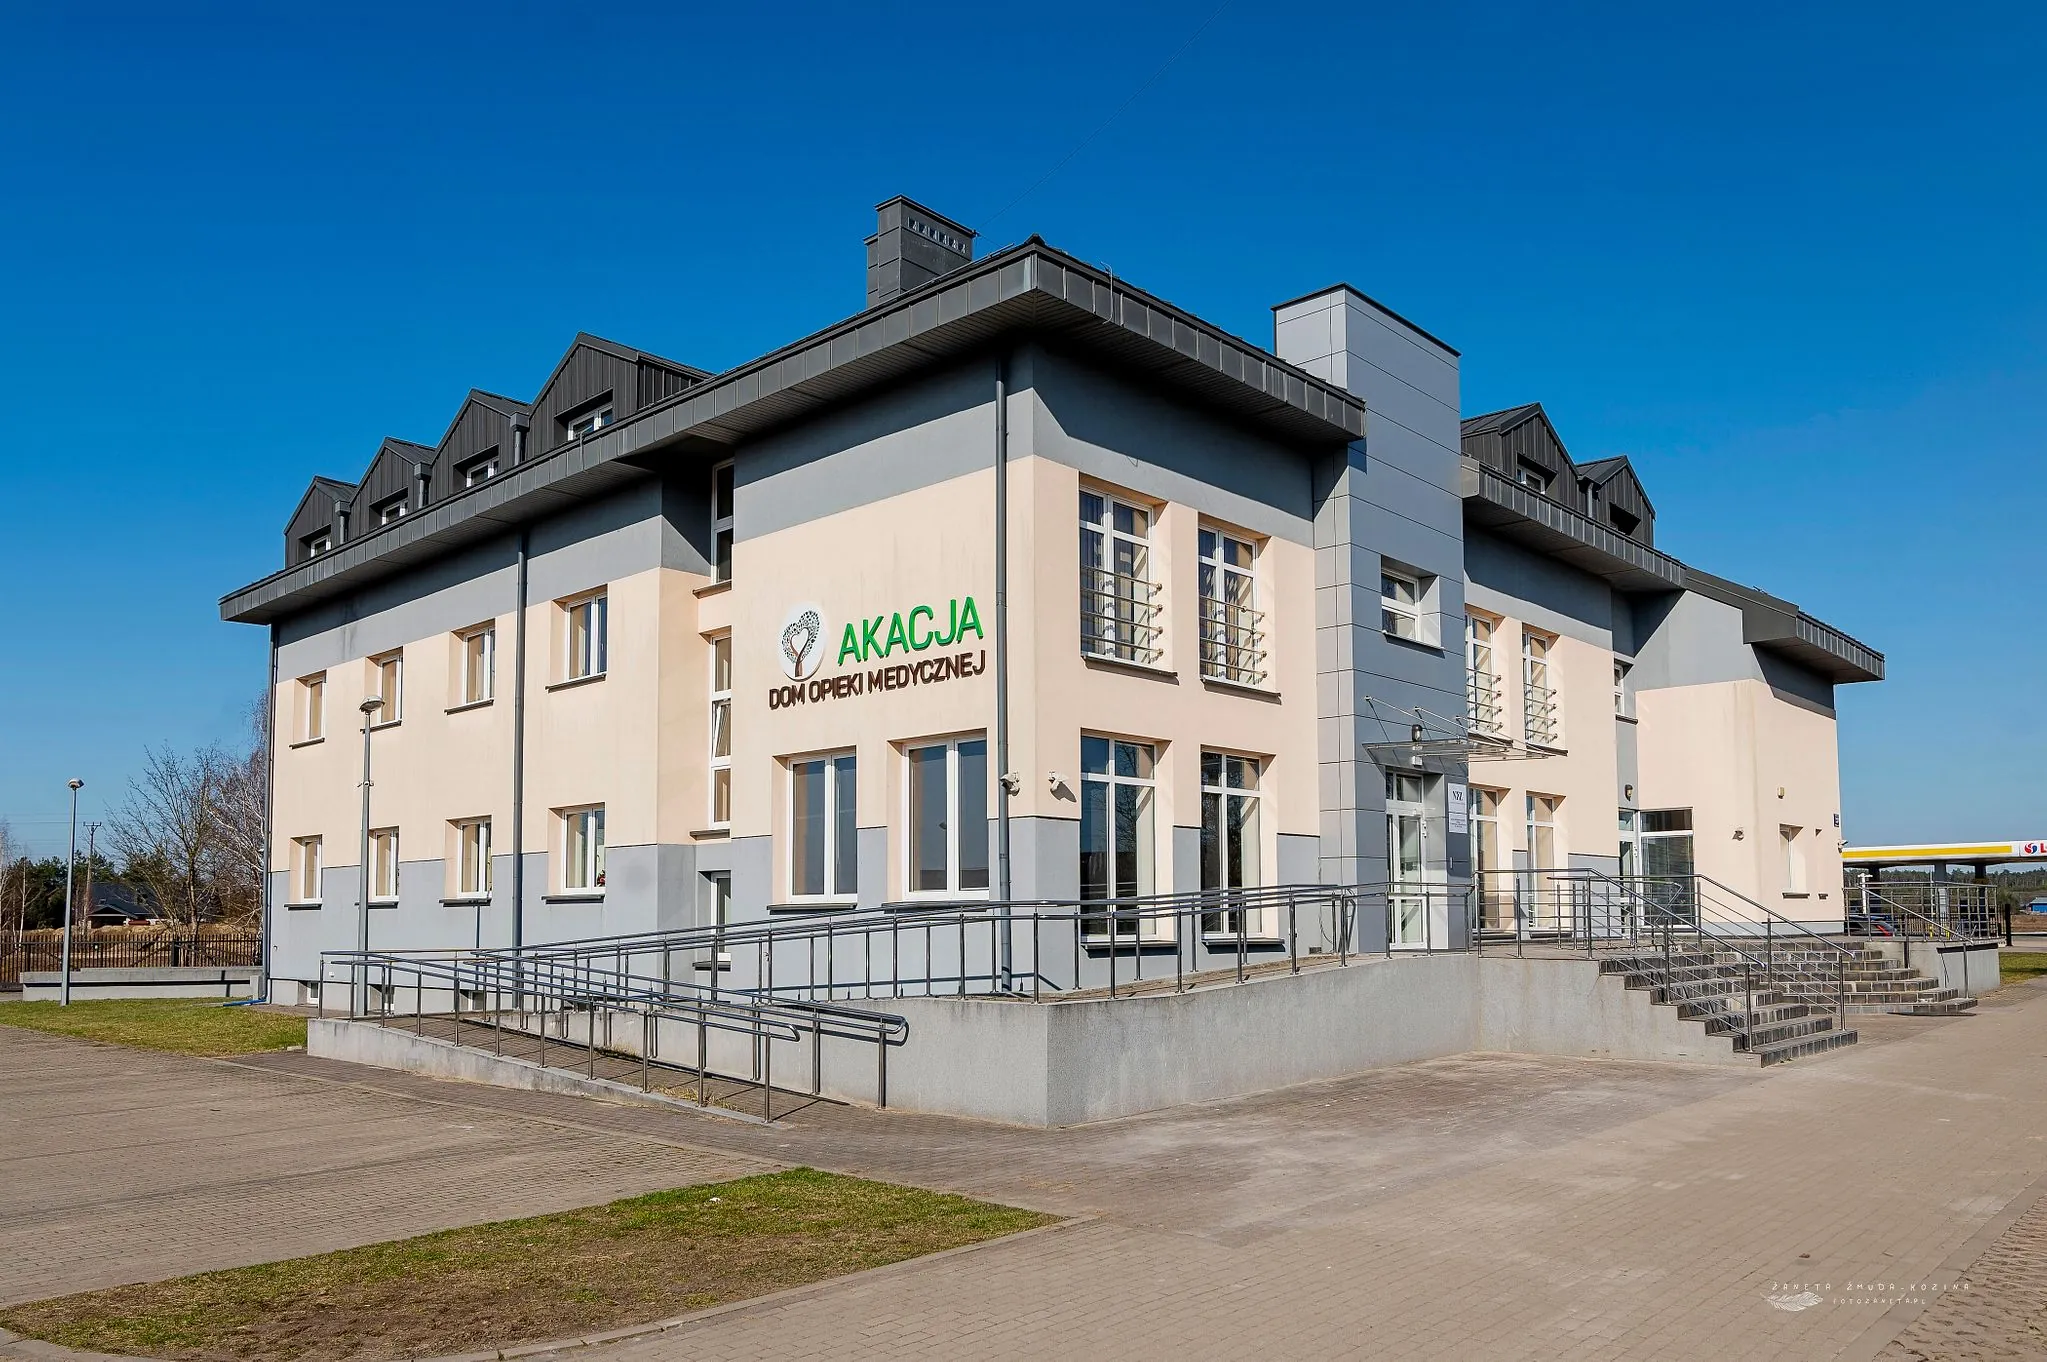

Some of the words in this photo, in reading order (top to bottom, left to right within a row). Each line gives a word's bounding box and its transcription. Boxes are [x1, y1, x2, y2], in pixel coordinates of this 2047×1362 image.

[837, 596, 984, 666] AKACJA
[769, 683, 805, 710] DOM
[808, 672, 863, 702] OPIEKI
[867, 650, 986, 693] MEDYCZNEJ
